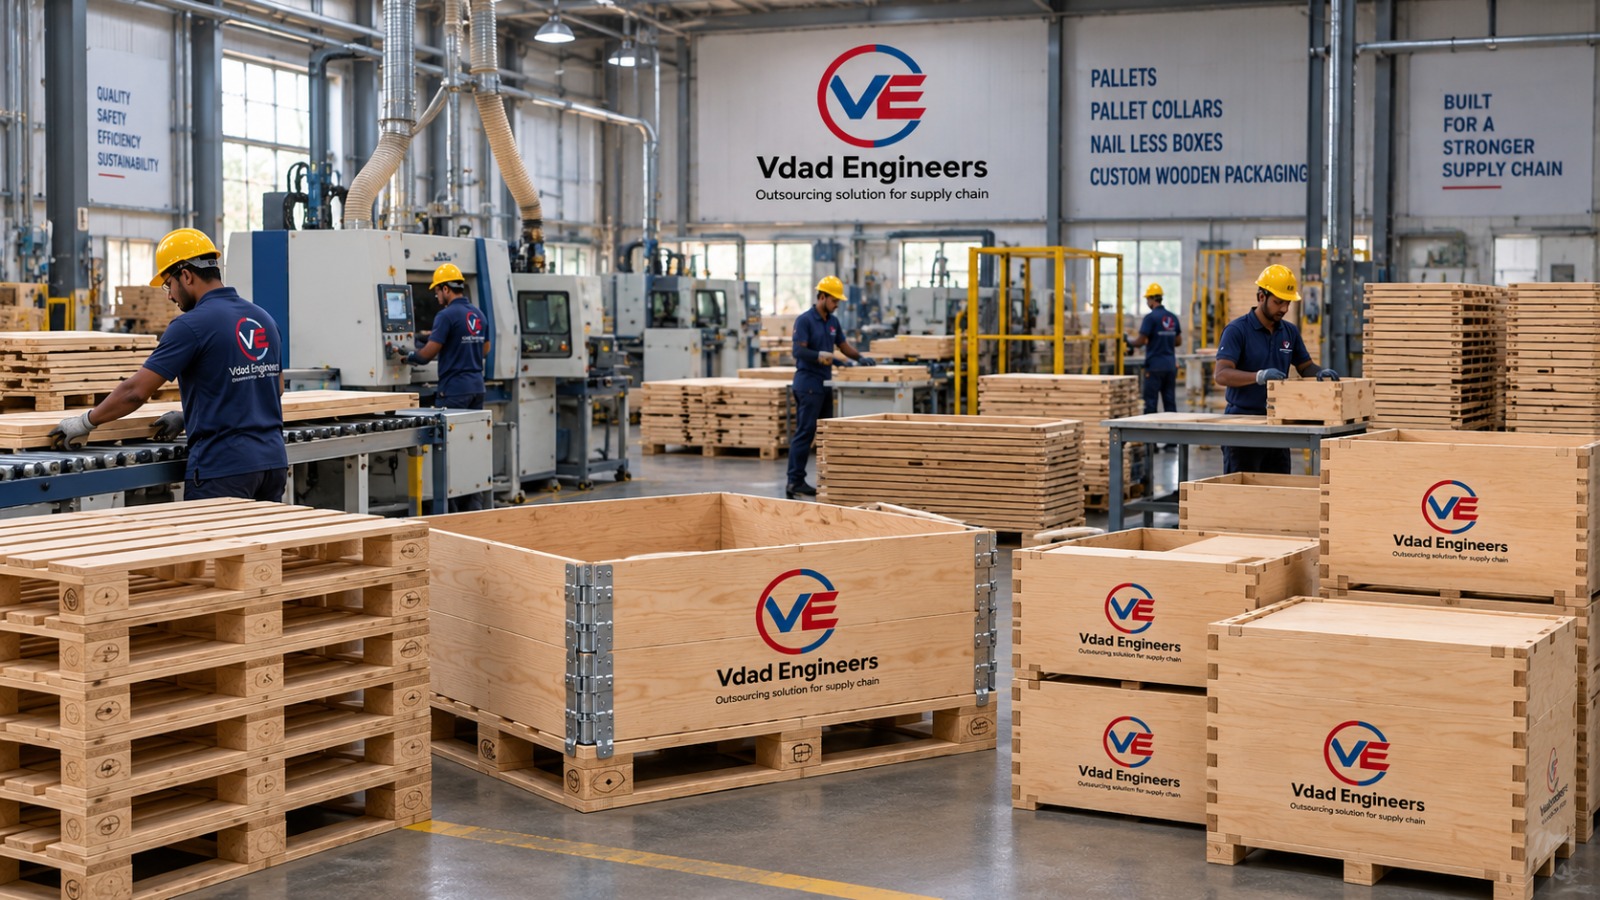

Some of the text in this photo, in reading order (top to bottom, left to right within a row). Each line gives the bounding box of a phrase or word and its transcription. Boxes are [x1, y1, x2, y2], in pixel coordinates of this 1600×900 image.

[1091, 68, 1156, 87] PALLETS
[97, 86, 131, 105] QUALITY
[1444, 94, 1492, 110] BUILT
[97, 108, 126, 126] SAFETY
[1091, 99, 1223, 120] PALLET COLLARS
[1444, 116, 1494, 132] FOR A
[97, 129, 141, 149] EFFICIENCY
[1091, 133, 1223, 153] NAIL LESS BOXES
[1443, 139, 1535, 155] STRONGER
[98, 152, 159, 172] SUSTAINABILITY
[757, 155, 988, 184] Vdad Engineers
[1442, 161, 1562, 177] SUPPLY CHAIN
[1090, 164, 1308, 185] CUSTOM WOODEN PACKAGING
[756, 188, 989, 202] Outsourcing solution for supply chain
[1393, 534, 1508, 552] Vdad Engineers
[1392, 550, 1430, 559] Outsourcing
[1079, 632, 1181, 652] Vdad Engineers
[717, 655, 878, 687] Vdad Engineers
[715, 677, 879, 705] Outsourcing solution for supply chain
[1078, 765, 1180, 788] Vdad Engineers
[1291, 782, 1425, 812] Vdad Engineers
[1290, 802, 1334, 815] Outsourcing
[1335, 808, 1364, 817] solution
[1378, 814, 1404, 824] supply
[1405, 816, 1426, 825] chain
